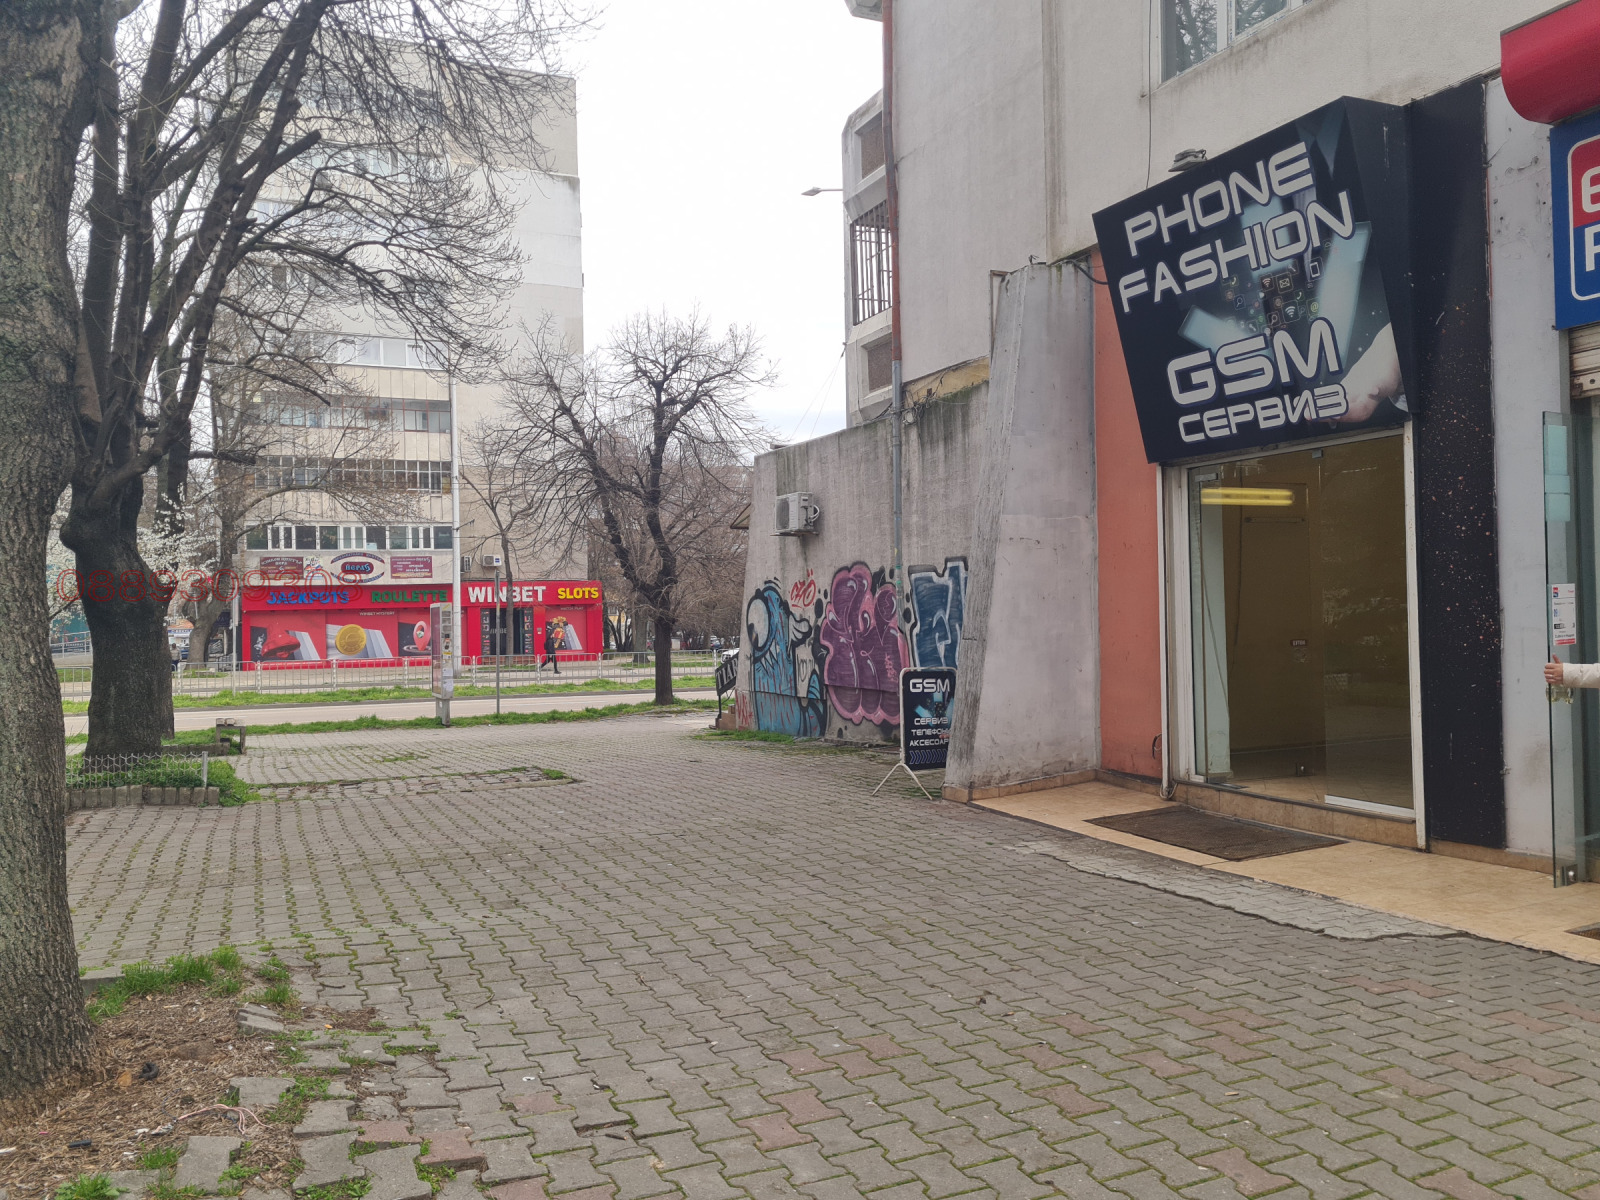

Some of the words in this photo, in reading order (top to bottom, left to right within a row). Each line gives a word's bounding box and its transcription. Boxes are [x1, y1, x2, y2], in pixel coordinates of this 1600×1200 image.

[1124, 141, 1315, 258] PHONE
[1118, 190, 1354, 314] FASHION
[1167, 317, 1340, 406] GSM
[1178, 383, 1350, 444] СЕРВИЗ
[266, 591, 350, 605] JACKPOTS
[371, 590, 448, 603] ROULETTE
[467, 586, 546, 603] WINBET
[557, 587, 599, 599] SLOTS
[909, 678, 950, 693] GSM
[914, 717, 949, 726] СЕРВИЗ
